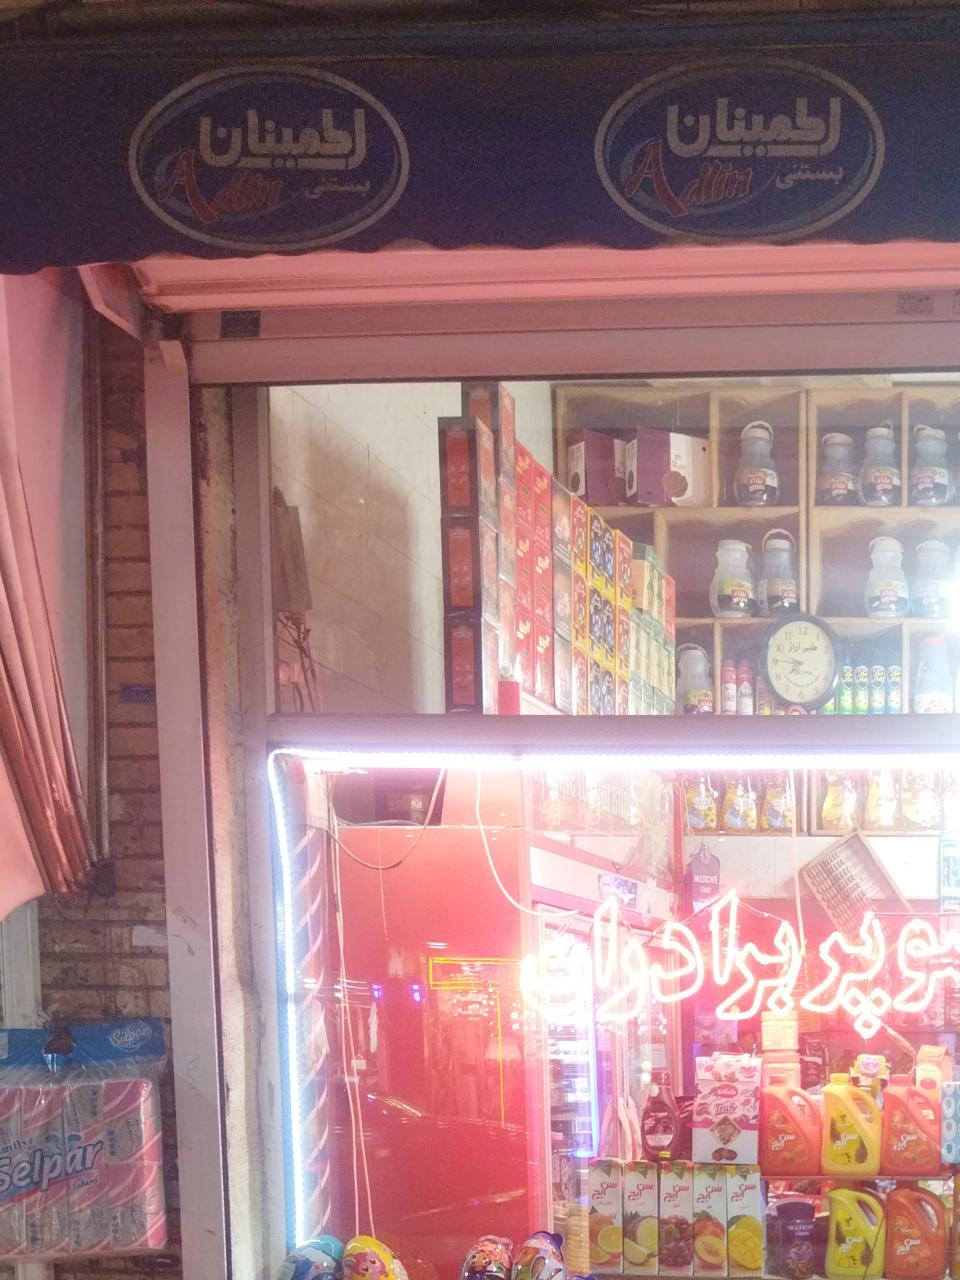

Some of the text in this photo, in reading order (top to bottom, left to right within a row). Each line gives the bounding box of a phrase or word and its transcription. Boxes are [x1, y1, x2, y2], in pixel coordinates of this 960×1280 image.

[200, 108, 366, 170] اطمینان
[667, 97, 841, 157] اطمینان
[305, 178, 370, 199] بستنی
[775, 163, 843, 190] بستنی
[0, 1140, 103, 1192] Selpar
